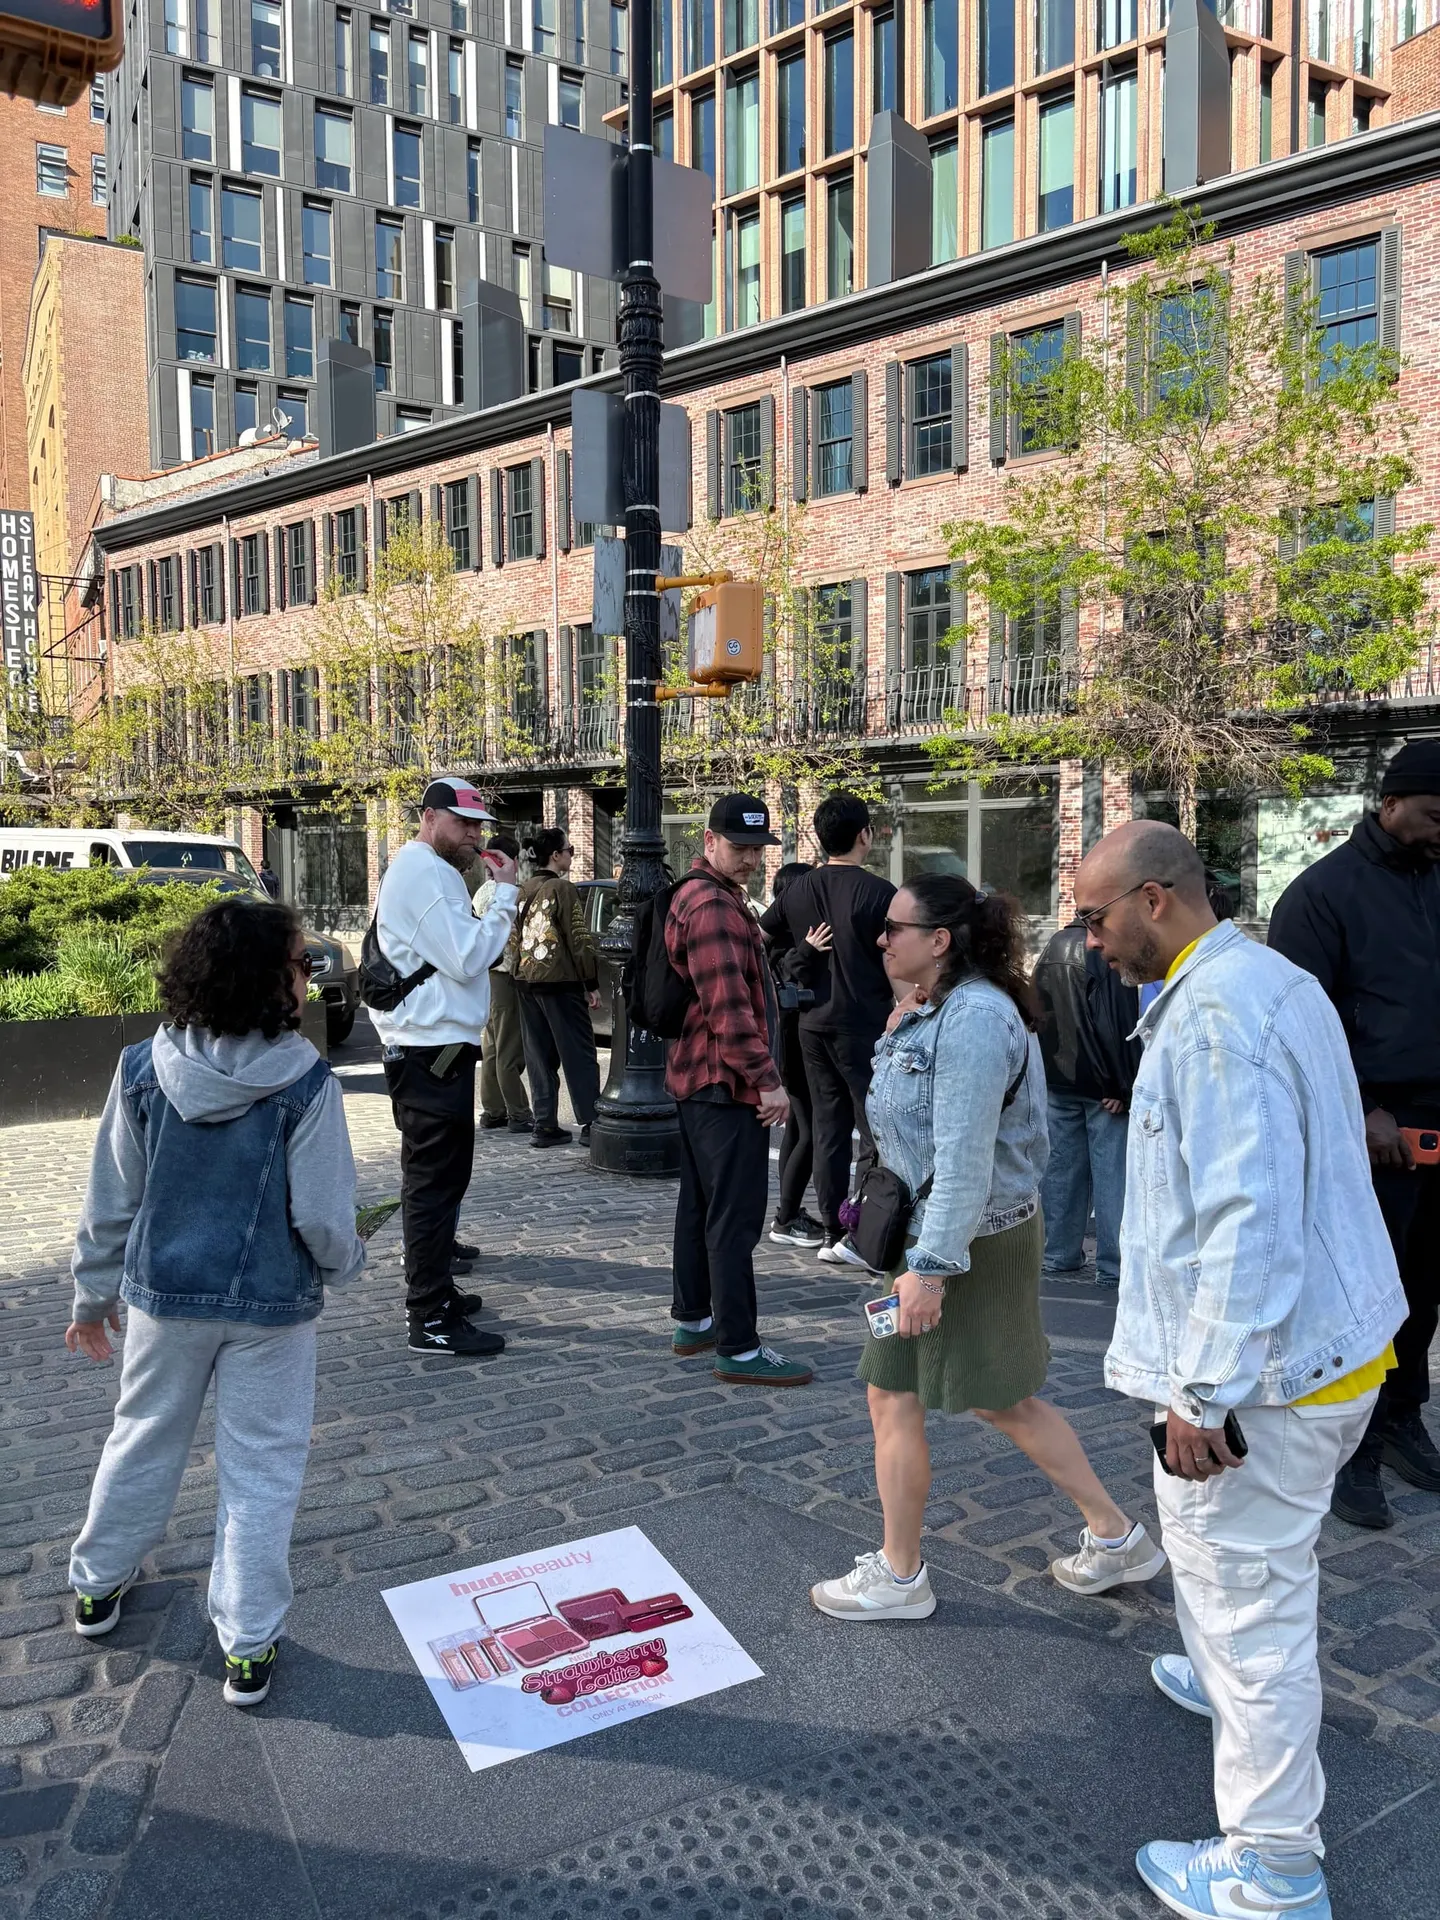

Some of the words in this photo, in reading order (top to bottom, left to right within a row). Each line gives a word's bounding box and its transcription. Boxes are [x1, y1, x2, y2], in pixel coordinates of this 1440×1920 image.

[19, 515, 35, 612] STEAK
[23, 618, 39, 713] HOUSE
[448, 1551, 592, 1597] hudabeauty
[523, 1637, 668, 1693] Strawberry
[568, 1650, 594, 1663] NEW
[556, 1672, 675, 1718] COLLECTION
[574, 1663, 641, 1697] Latte
[592, 1707, 615, 1721] ONLY
[616, 1703, 627, 1713] AT
[628, 1692, 666, 1710] SEPHORA
